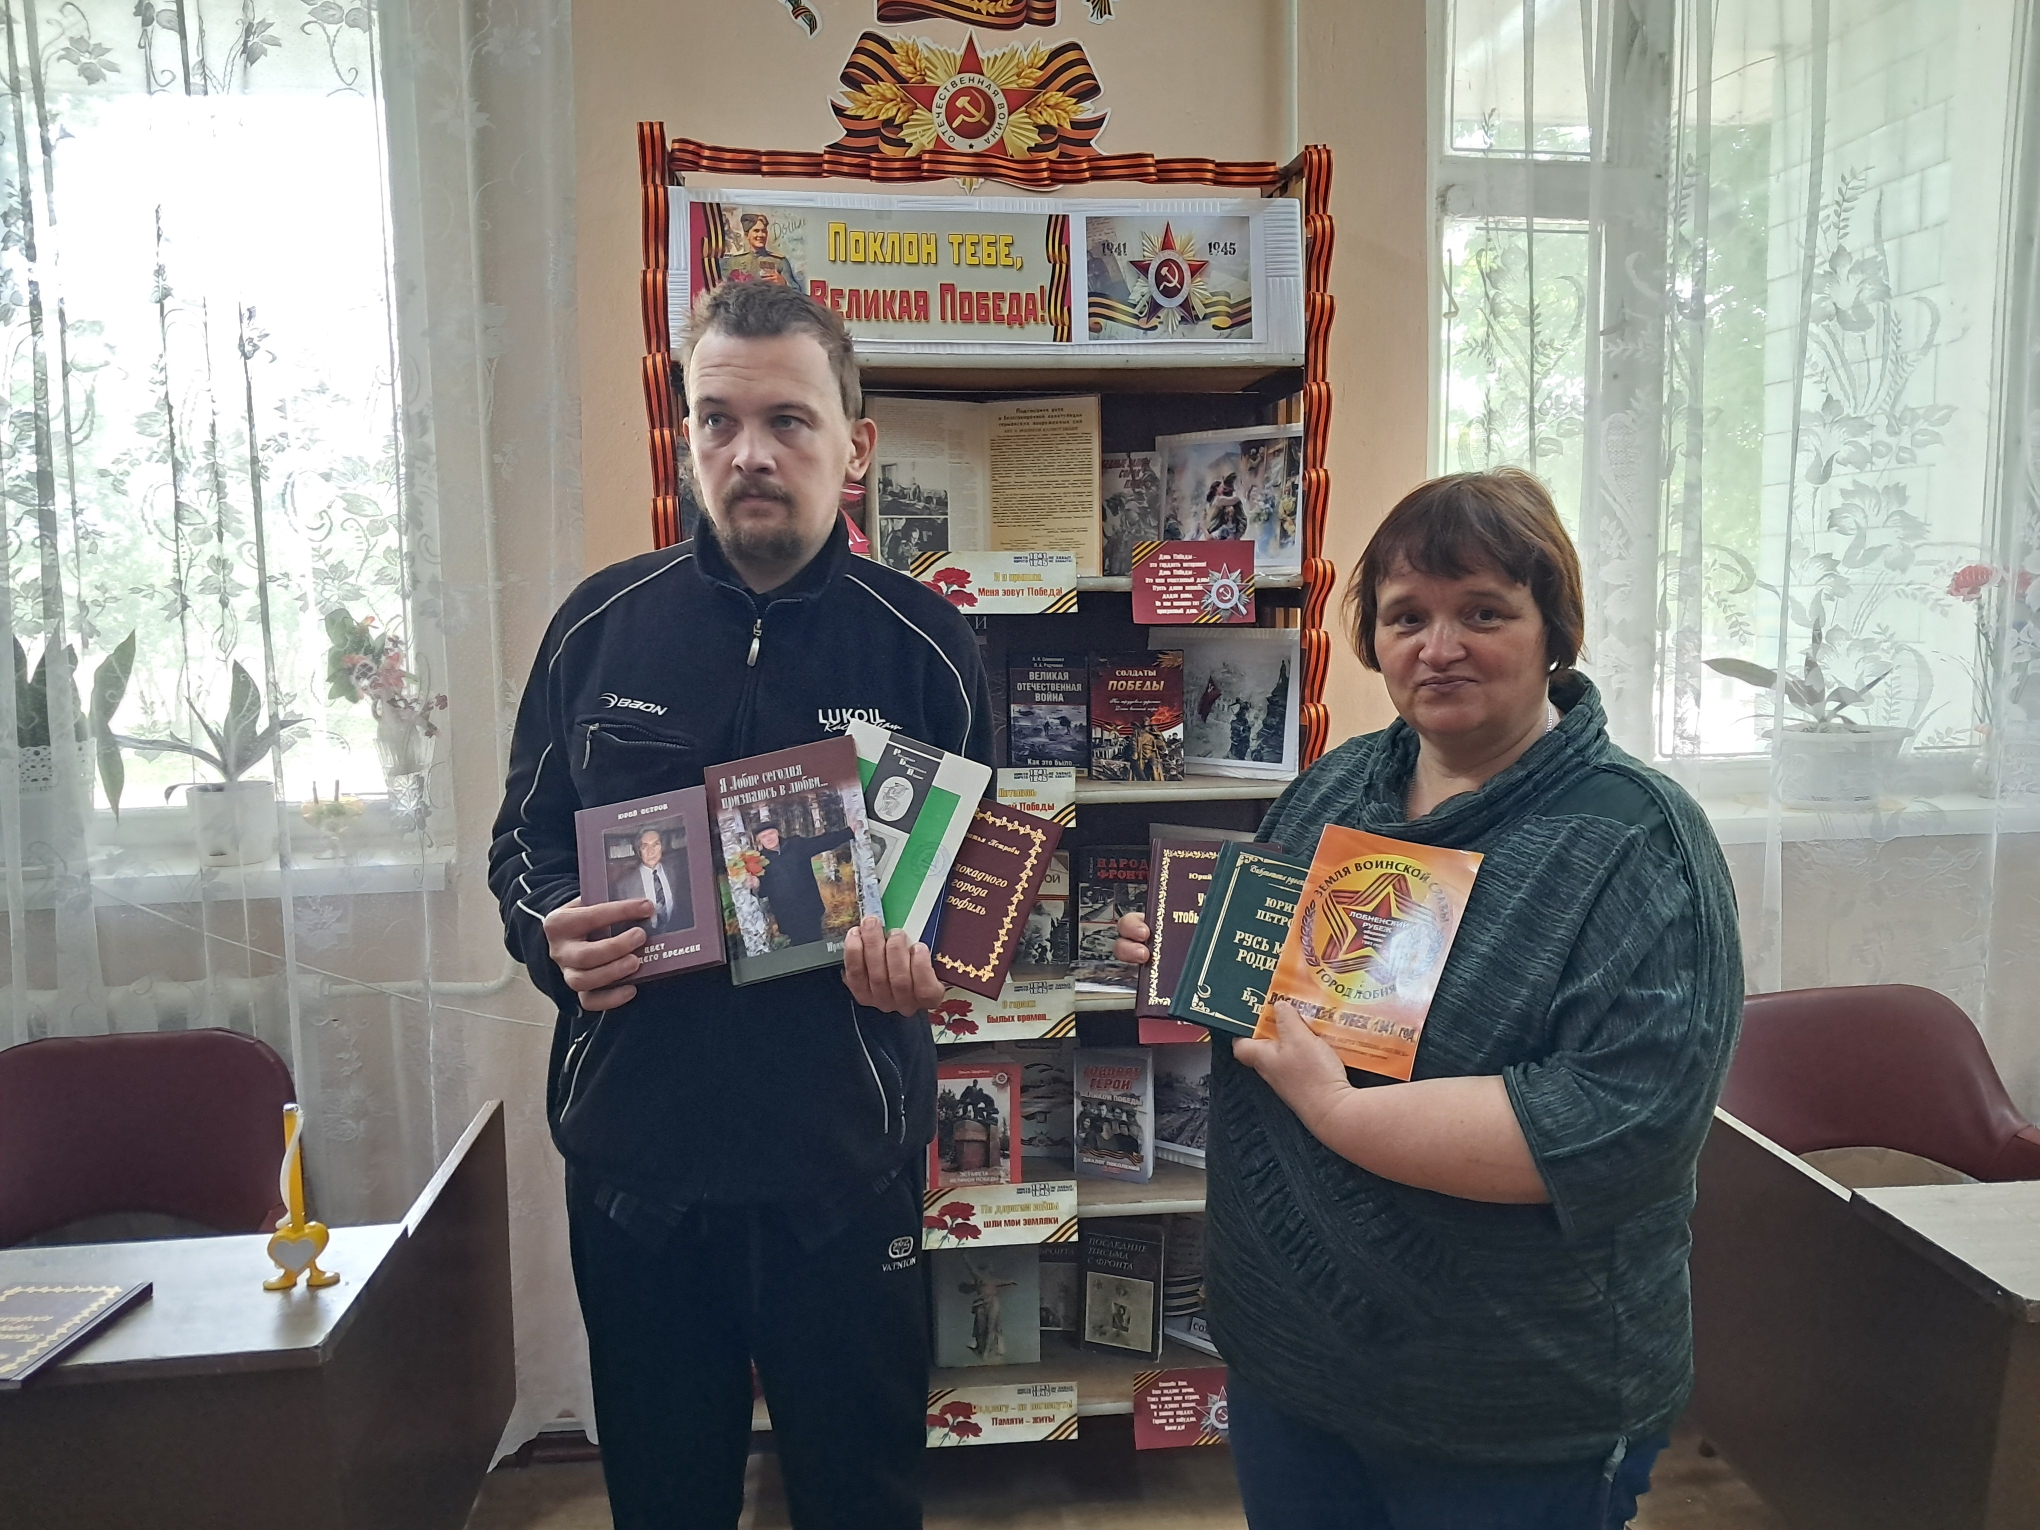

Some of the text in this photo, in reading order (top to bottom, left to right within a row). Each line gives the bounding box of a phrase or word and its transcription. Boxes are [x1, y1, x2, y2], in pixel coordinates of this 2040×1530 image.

[935, 76, 999, 143] ОТЕЧЕСТВЕННАЯ
[827, 222, 938, 264] ПОКЛОН
[1101, 242, 1127, 256] 1941
[1207, 241, 1236, 256] 1945
[939, 283, 1048, 327] ПОБЕДА!
[977, 586, 1063, 598] Меня зовут Победа!
[1028, 671, 1069, 680] ВЕЛИКАЯ
[1115, 669, 1157, 677] СОЛДАТЫ
[1016, 682, 1082, 691] ОТЕЧЕСТВЕННАЯ
[1107, 680, 1165, 691] ПОБЕДЫ
[1035, 691, 1064, 702] ВОЙНА
[818, 708, 886, 724] LUKOIL
[719, 764, 802, 794] Я Лобне сегодня
[720, 775, 829, 813] признаюсь в любви...
[987, 838, 1021, 856] Петровы
[1314, 866, 1351, 898] ЗЕМЛЯ
[1354, 860, 1432, 884] ВОИНСКОЙ
[951, 878, 988, 898] города
[1264, 896, 1297, 914] ЮРИ
[1361, 921, 1393, 933] РУБЕЖ
[1233, 930, 1285, 955] РУСЬ М
[1235, 948, 1278, 972] РОДИ
[1315, 968, 1397, 1000] ГОРОД ЛОБНЯ
[986, 1014, 1015, 1024] былых
[983, 1220, 1003, 1228] шли
[1003, 1219, 1021, 1227] мои
[1088, 1237, 1147, 1253] ПОСЛЕДНИЕ
[1088, 1247, 1129, 1259] ПИСЬМА
[1096, 1258, 1134, 1270] ФРОНТА
[991, 1417, 1024, 1426] Памяти
